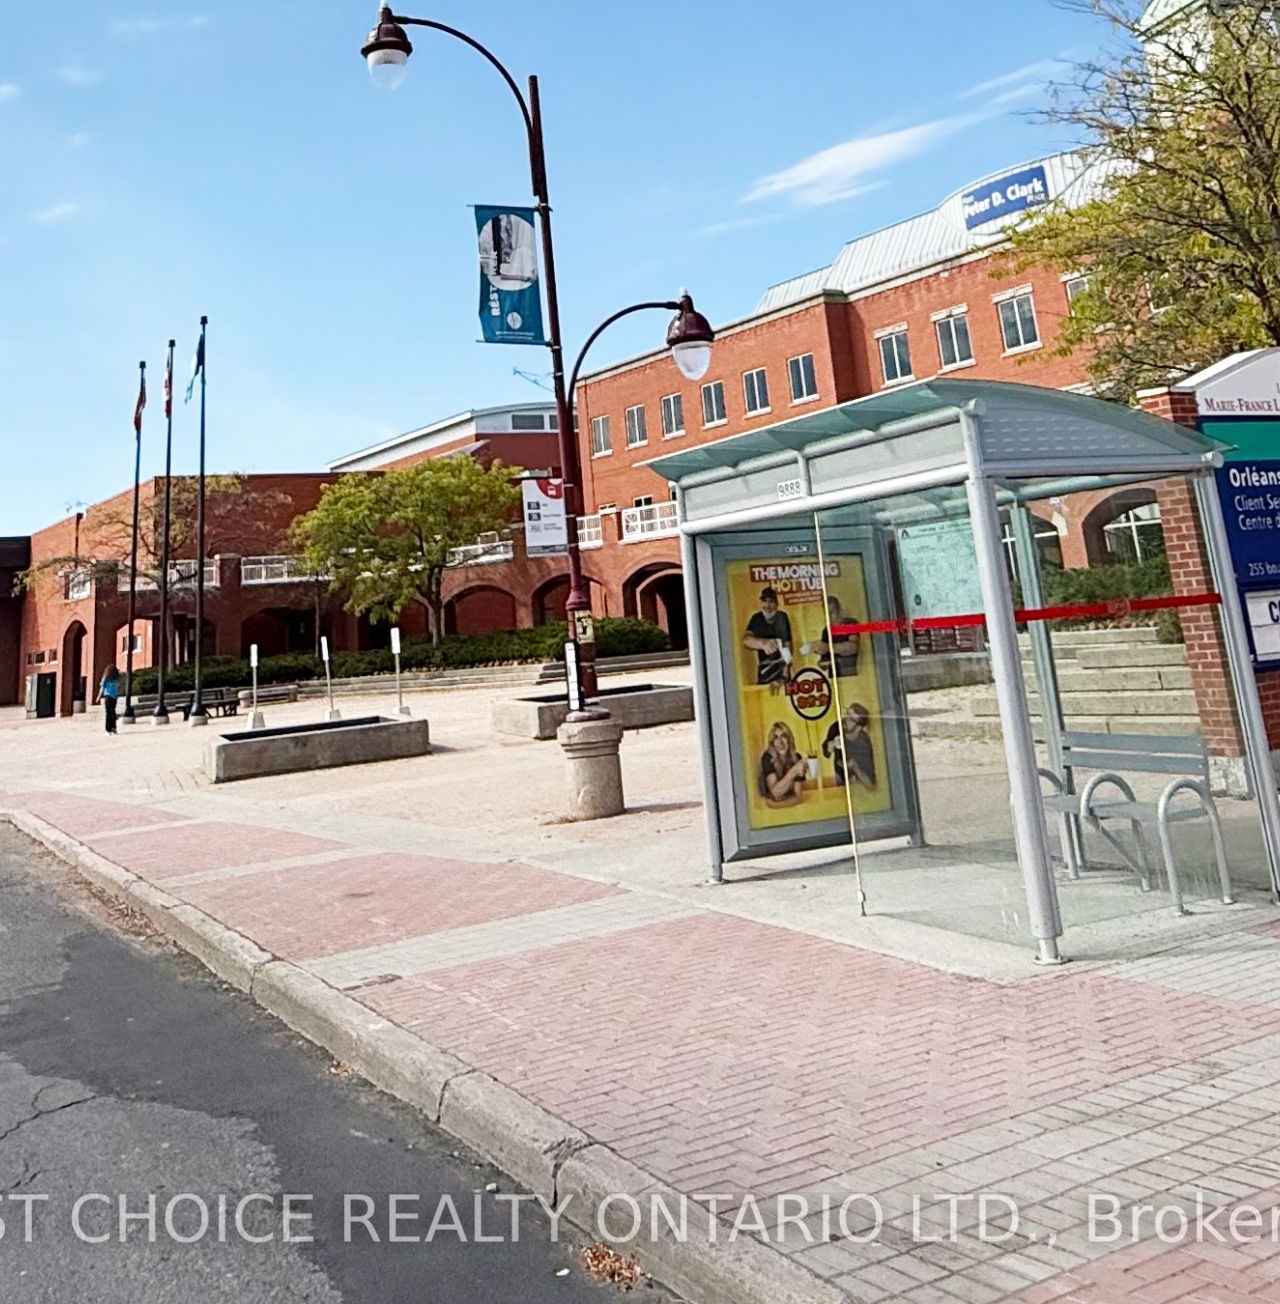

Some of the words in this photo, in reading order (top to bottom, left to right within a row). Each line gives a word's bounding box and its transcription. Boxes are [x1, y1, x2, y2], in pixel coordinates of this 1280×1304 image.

[963, 198, 990, 219] Peter
[991, 191, 1005, 207] D.
[1006, 177, 1044, 201] Clark
[1205, 398, 1273, 412] MARIE-FRANCE
[1234, 495, 1266, 512] Client
[1238, 515, 1274, 531] Centre
[752, 566, 777, 581] THE
[1248, 562, 1265, 576] 255
[771, 579, 799, 593] HOT
[785, 678, 824, 696] HOT
